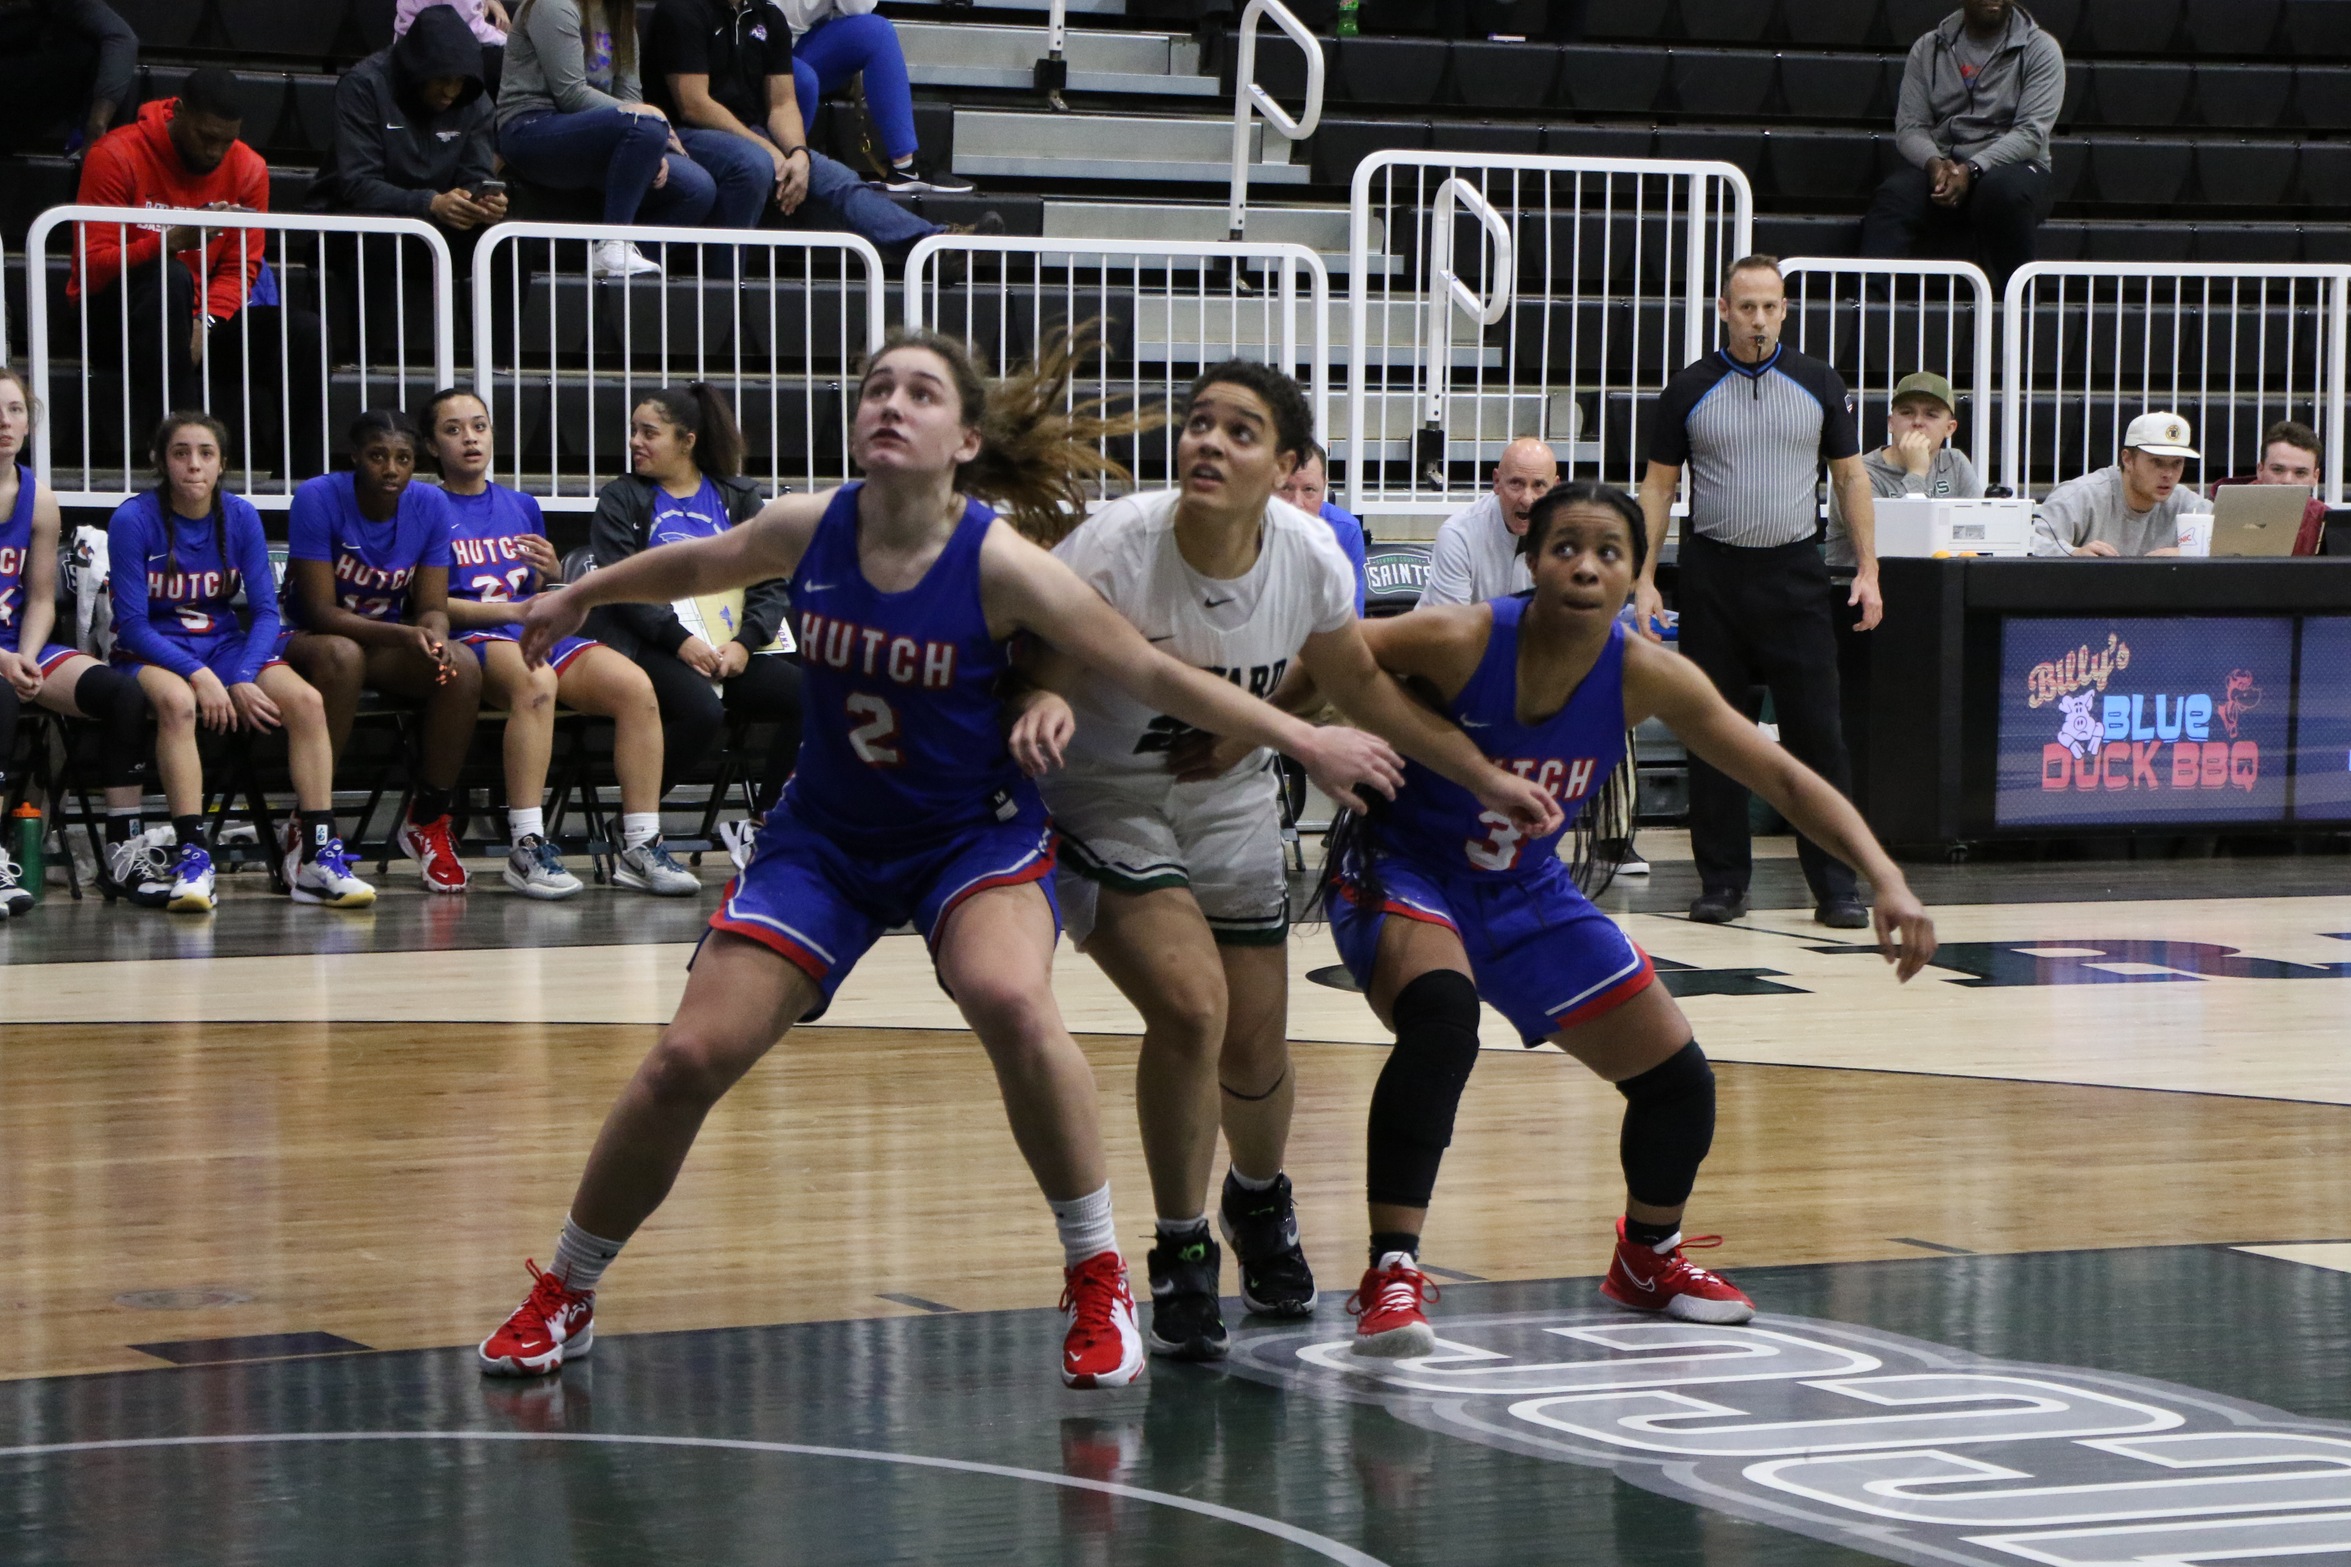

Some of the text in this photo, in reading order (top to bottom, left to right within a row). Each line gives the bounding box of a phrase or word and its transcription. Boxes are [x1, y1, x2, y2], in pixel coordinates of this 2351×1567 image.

[175, 604, 215, 632] 5
[799, 612, 956, 690] HUTCH
[2028, 632, 2131, 709] Billy's
[846, 691, 902, 765] 2
[993, 790, 1006, 804] M
[2041, 741, 2260, 793] DUCK BBQ
[1465, 810, 1524, 872] 3
